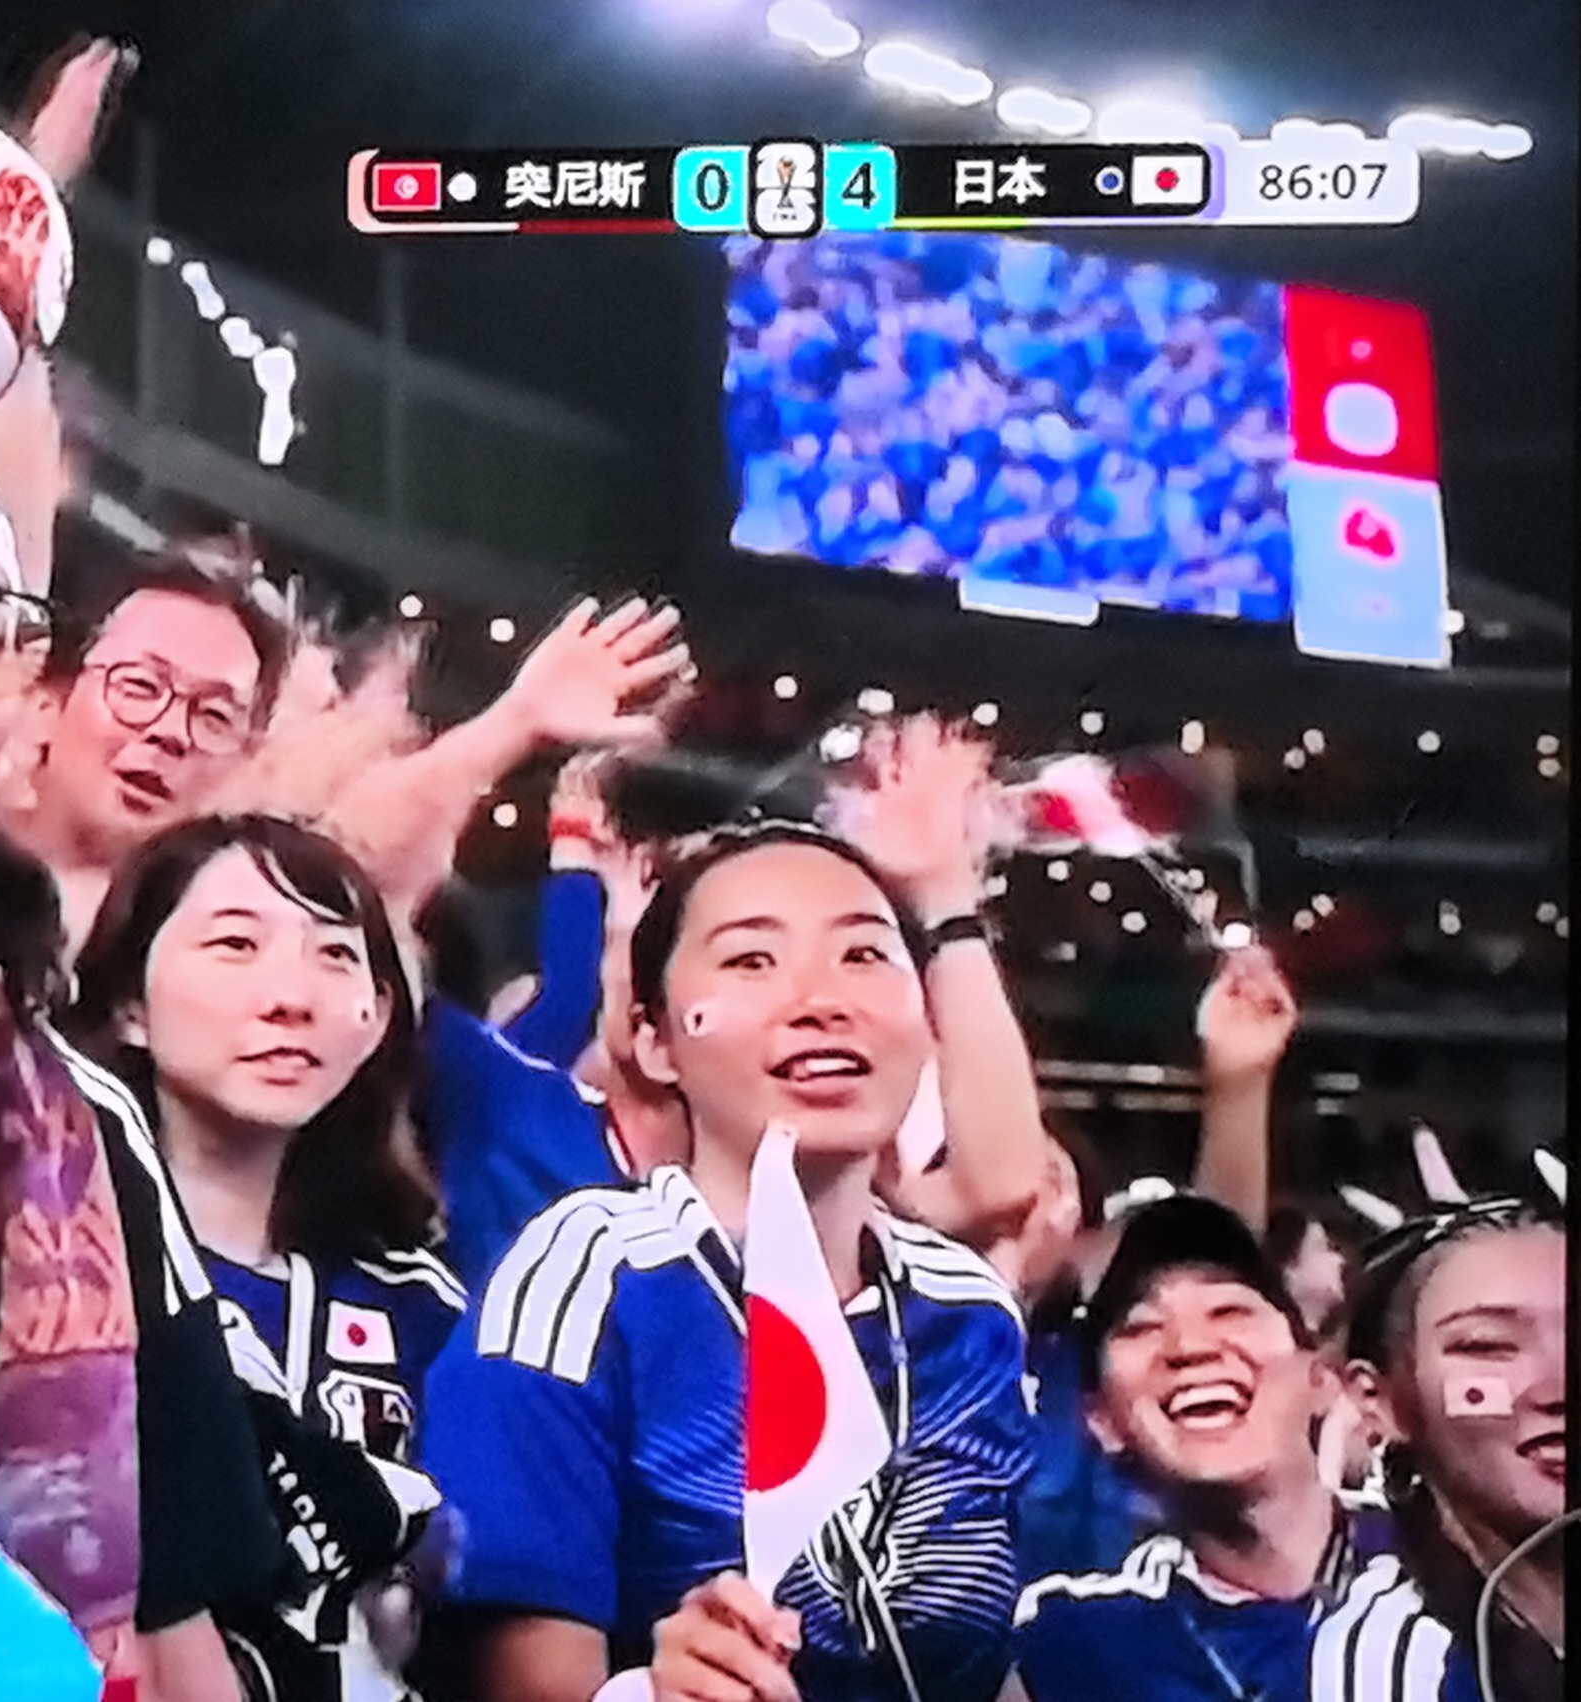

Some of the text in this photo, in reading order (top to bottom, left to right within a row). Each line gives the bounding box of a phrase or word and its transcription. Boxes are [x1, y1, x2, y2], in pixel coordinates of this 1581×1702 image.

[505, 160, 1387, 211] 突尼斯 0 4 日本 86:07
